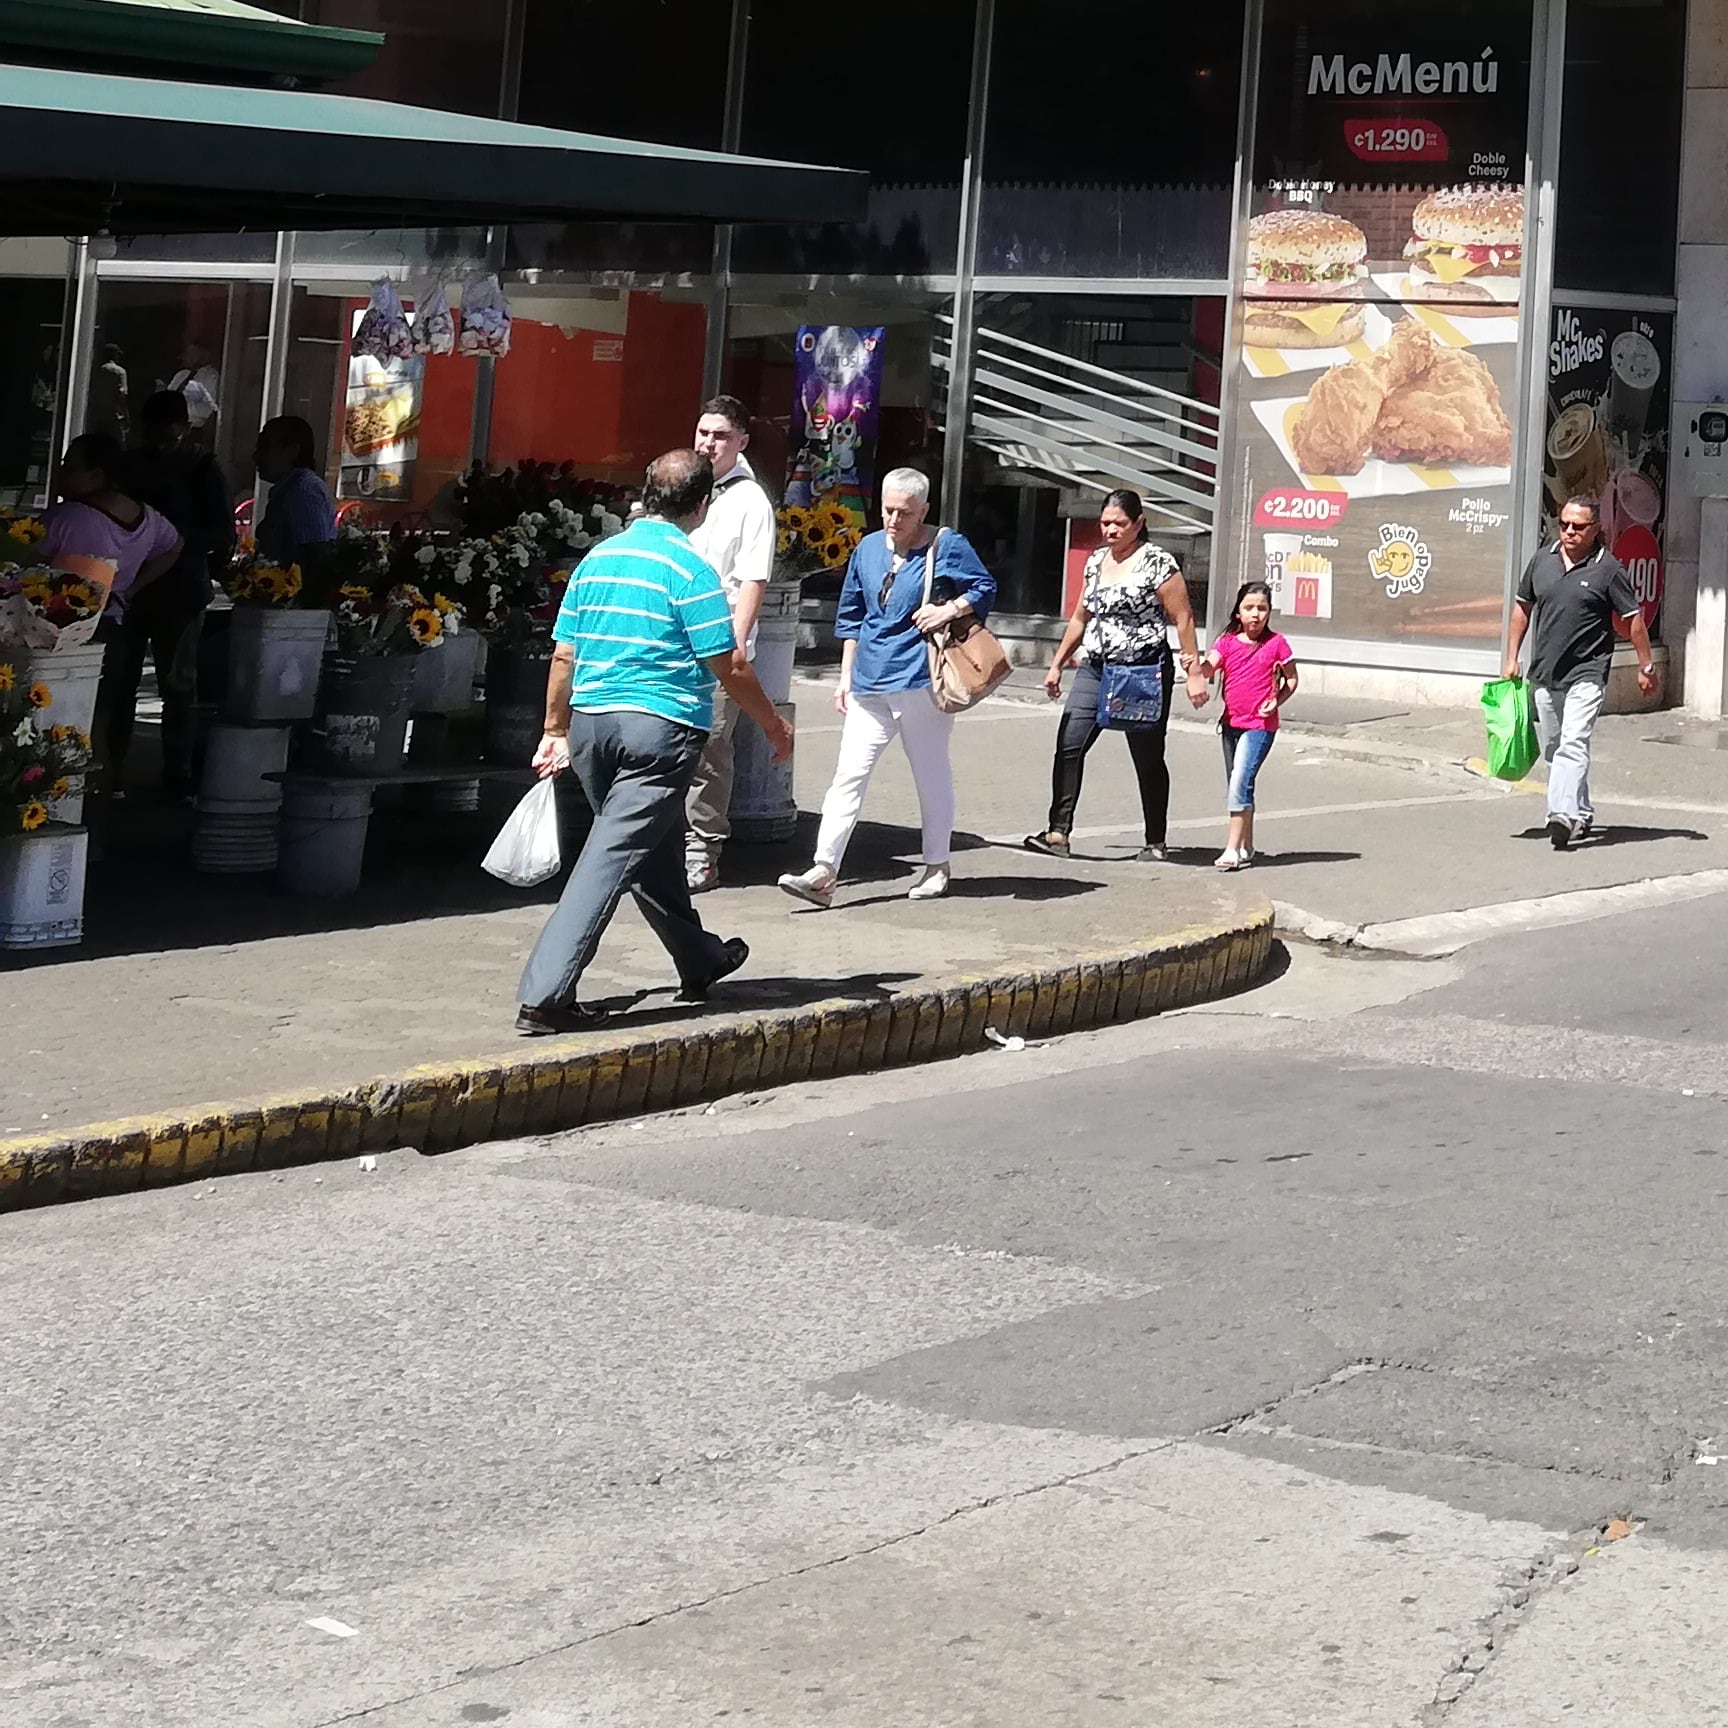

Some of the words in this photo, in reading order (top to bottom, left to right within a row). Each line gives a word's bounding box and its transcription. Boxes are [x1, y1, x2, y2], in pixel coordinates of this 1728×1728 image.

[1307, 46, 1500, 95] McMenú
[1472, 152, 1506, 164] Doble
[1468, 165, 1510, 179] Cheesy
[1301, 178, 1335, 193] Honey
[1289, 190, 1313, 203] BBQ
[1557, 309, 1580, 342] Mc
[1549, 331, 1604, 375] Shakes
[1264, 496, 1329, 520] ¢2.200
[1462, 497, 1491, 511] Pollo
[1381, 526, 1415, 542] Bien
[1466, 522, 1472, 532] 2
[1473, 525, 1484, 535] pz
[1304, 534, 1339, 547] Combo
[1388, 546, 1429, 595] Jugado
